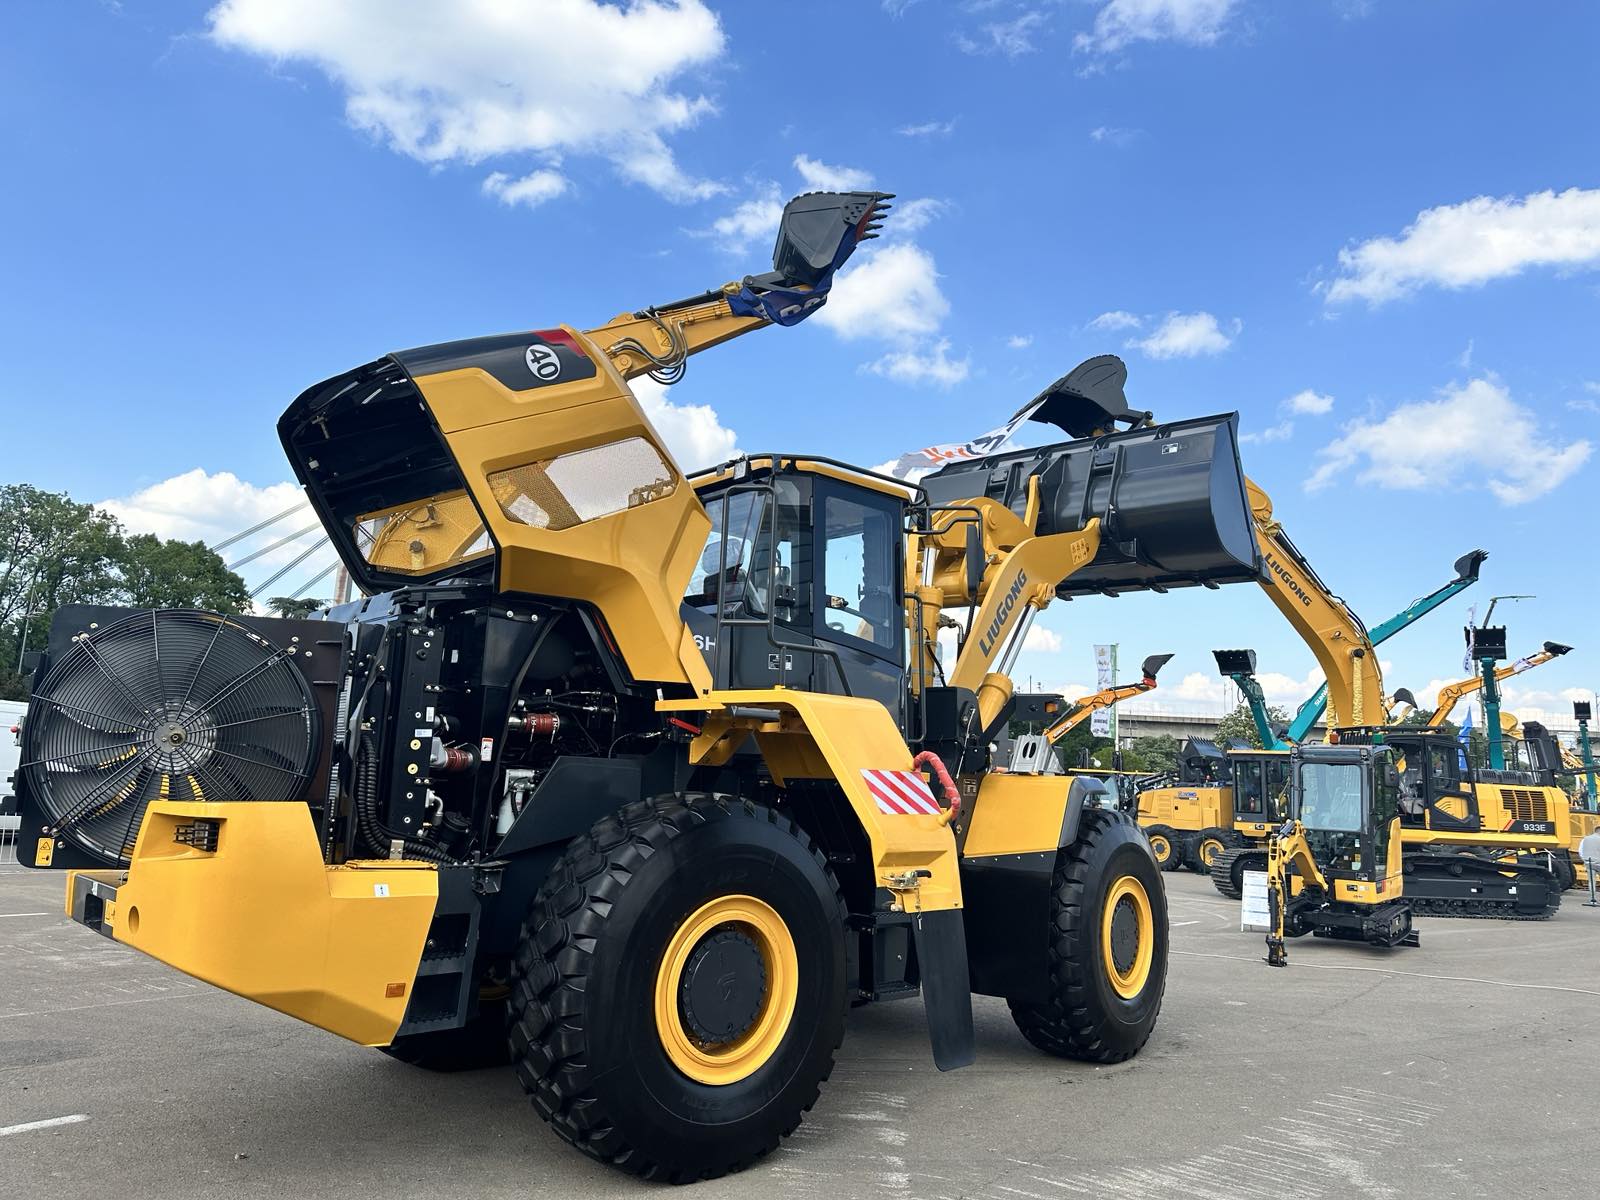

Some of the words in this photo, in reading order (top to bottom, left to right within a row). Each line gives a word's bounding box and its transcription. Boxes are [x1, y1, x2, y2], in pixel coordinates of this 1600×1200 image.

[529, 348, 559, 378] 40
[1264, 552, 1313, 607] LIUGONG
[979, 567, 1028, 657] LIUGONG
[1523, 823, 1546, 832] 933E
